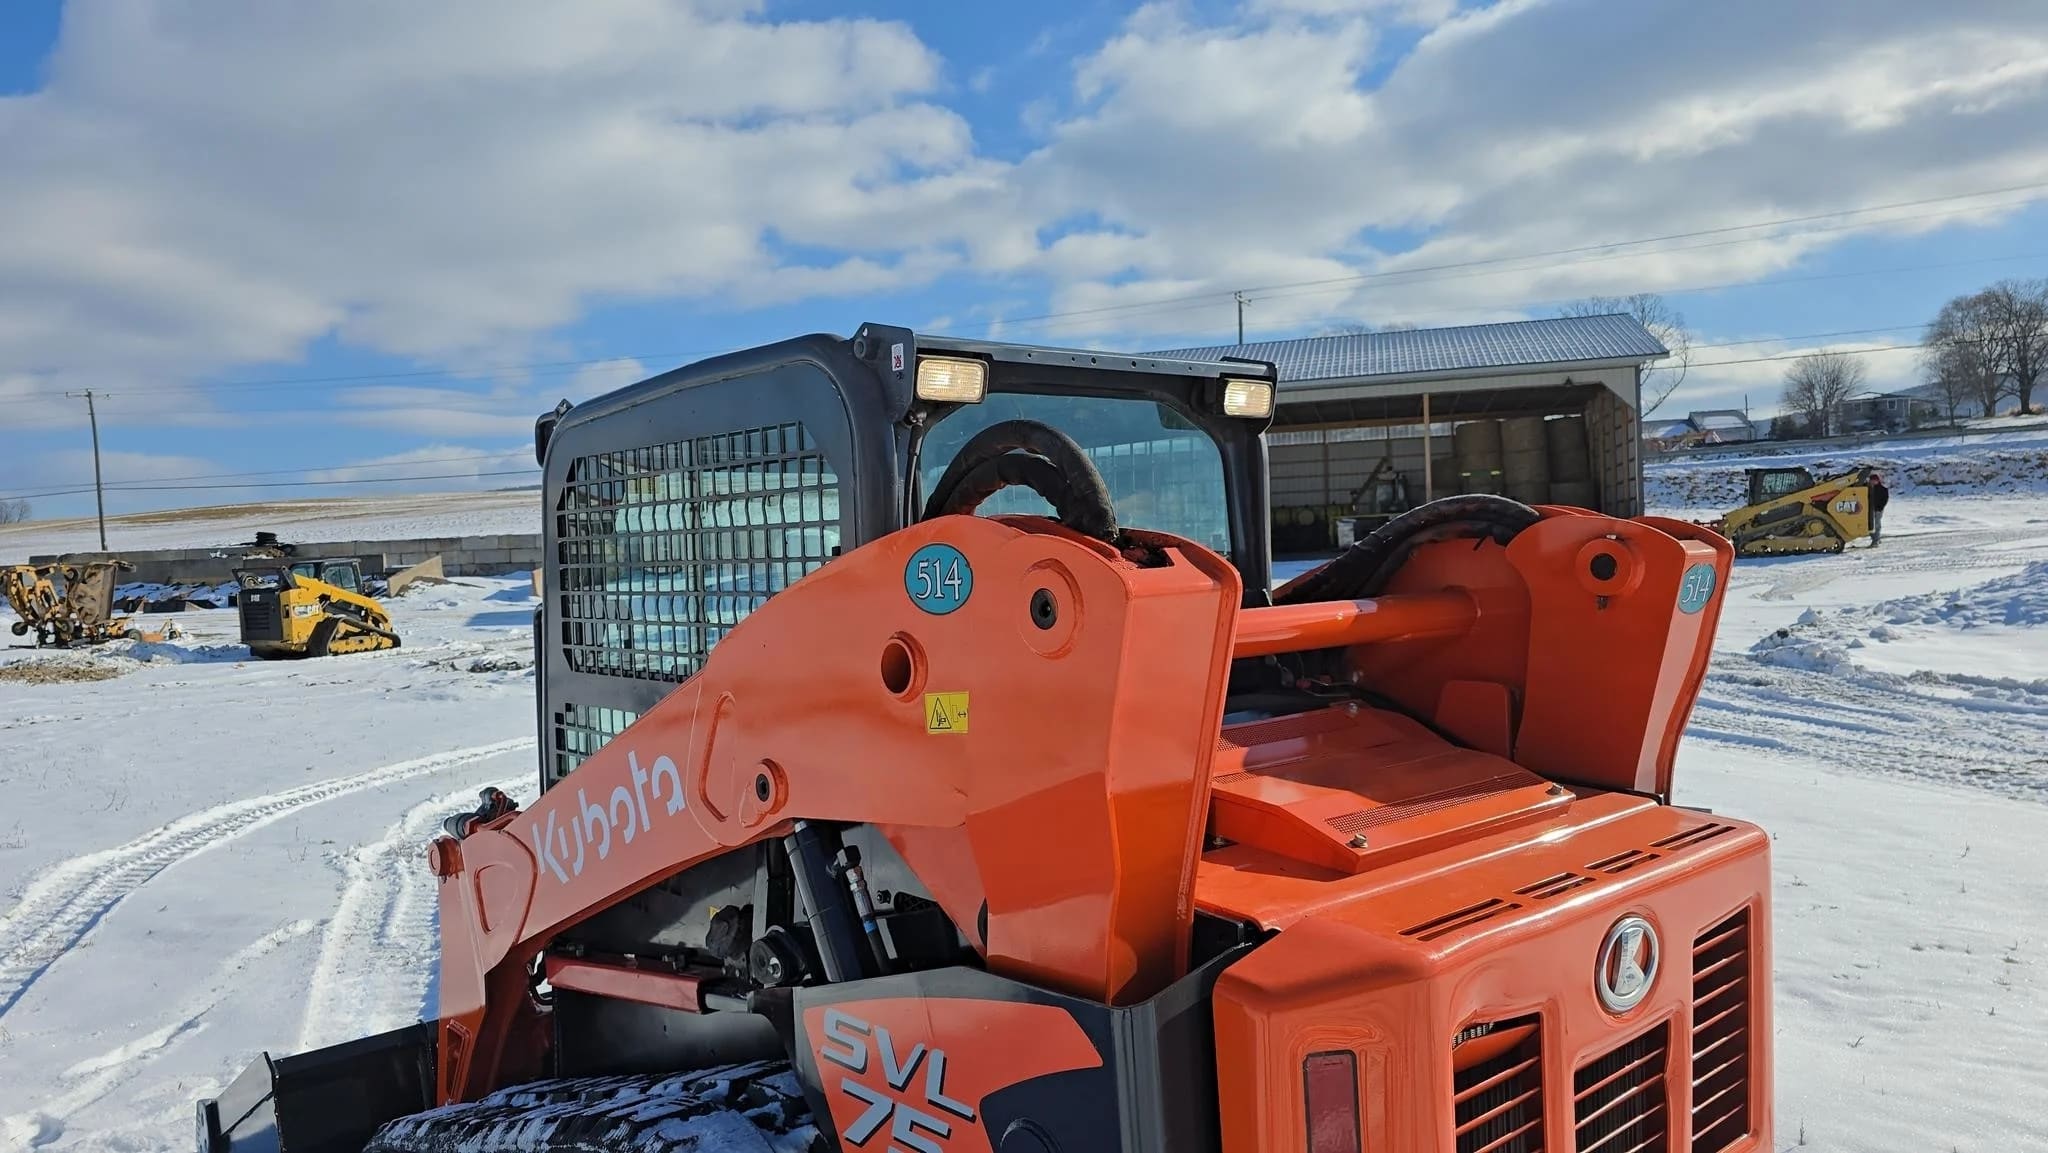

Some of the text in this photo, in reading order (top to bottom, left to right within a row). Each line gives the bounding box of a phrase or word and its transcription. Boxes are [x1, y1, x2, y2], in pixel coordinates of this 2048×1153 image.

[1836, 500, 1857, 513] CAT
[915, 557, 963, 601] 514
[1681, 573, 1711, 603] 514
[531, 750, 687, 885] Kubota
[820, 1007, 977, 1124] SVL
